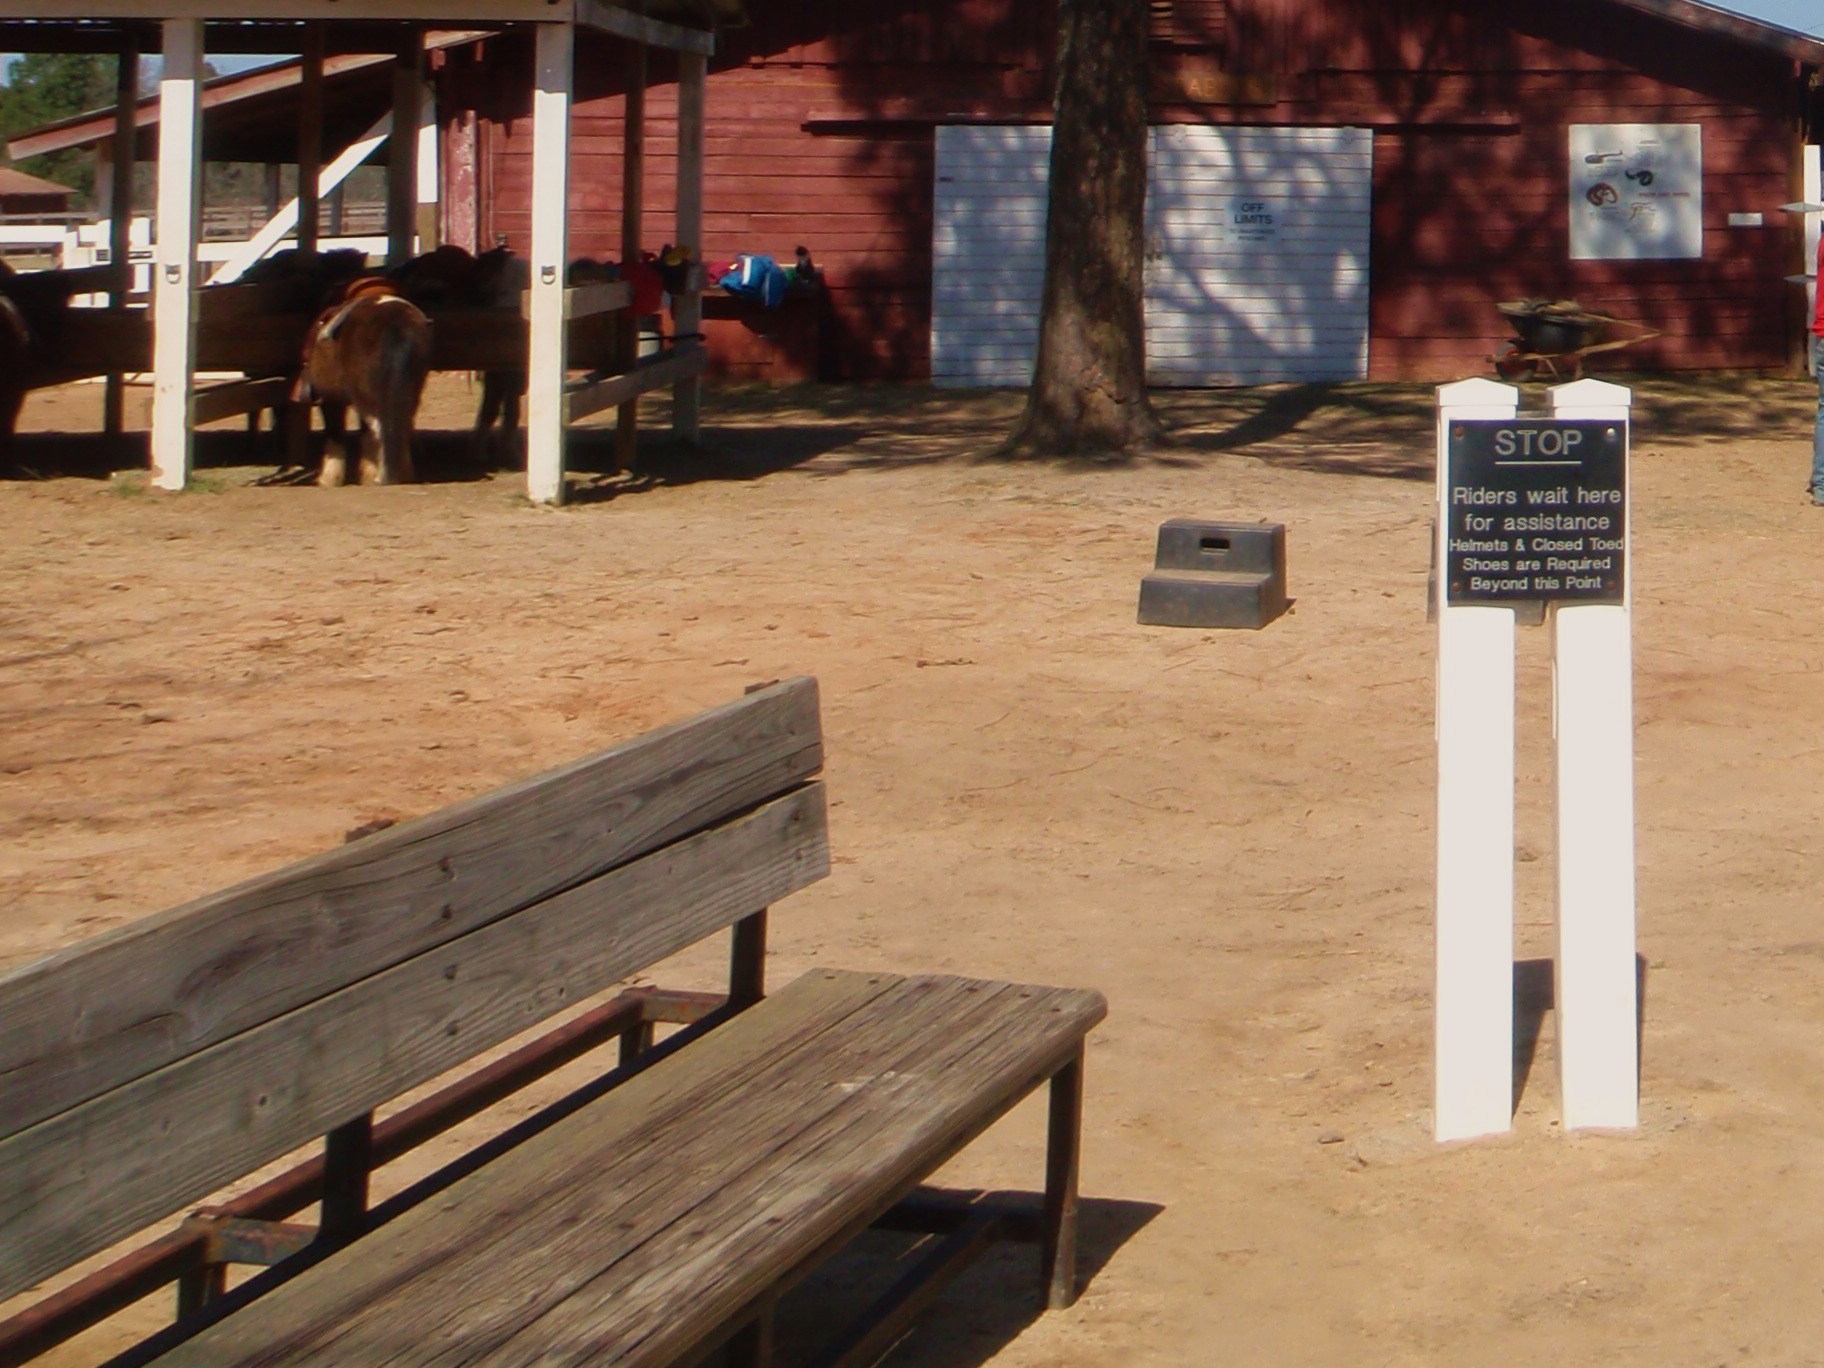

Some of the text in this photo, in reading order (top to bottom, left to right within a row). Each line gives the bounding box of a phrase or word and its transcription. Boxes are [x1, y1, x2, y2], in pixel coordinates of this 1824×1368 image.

[1241, 203, 1264, 212] OFF
[1234, 214, 1273, 224] LIMITS
[1494, 429, 1583, 456] STOP
[1453, 486, 1622, 505] Riders wait here
[1465, 513, 1610, 531] for assistance
[1449, 536, 1624, 552] Helmets & Closed Toed
[1462, 556, 1611, 572] Shoes are Required
[1470, 575, 1602, 593] Beyond this Point
